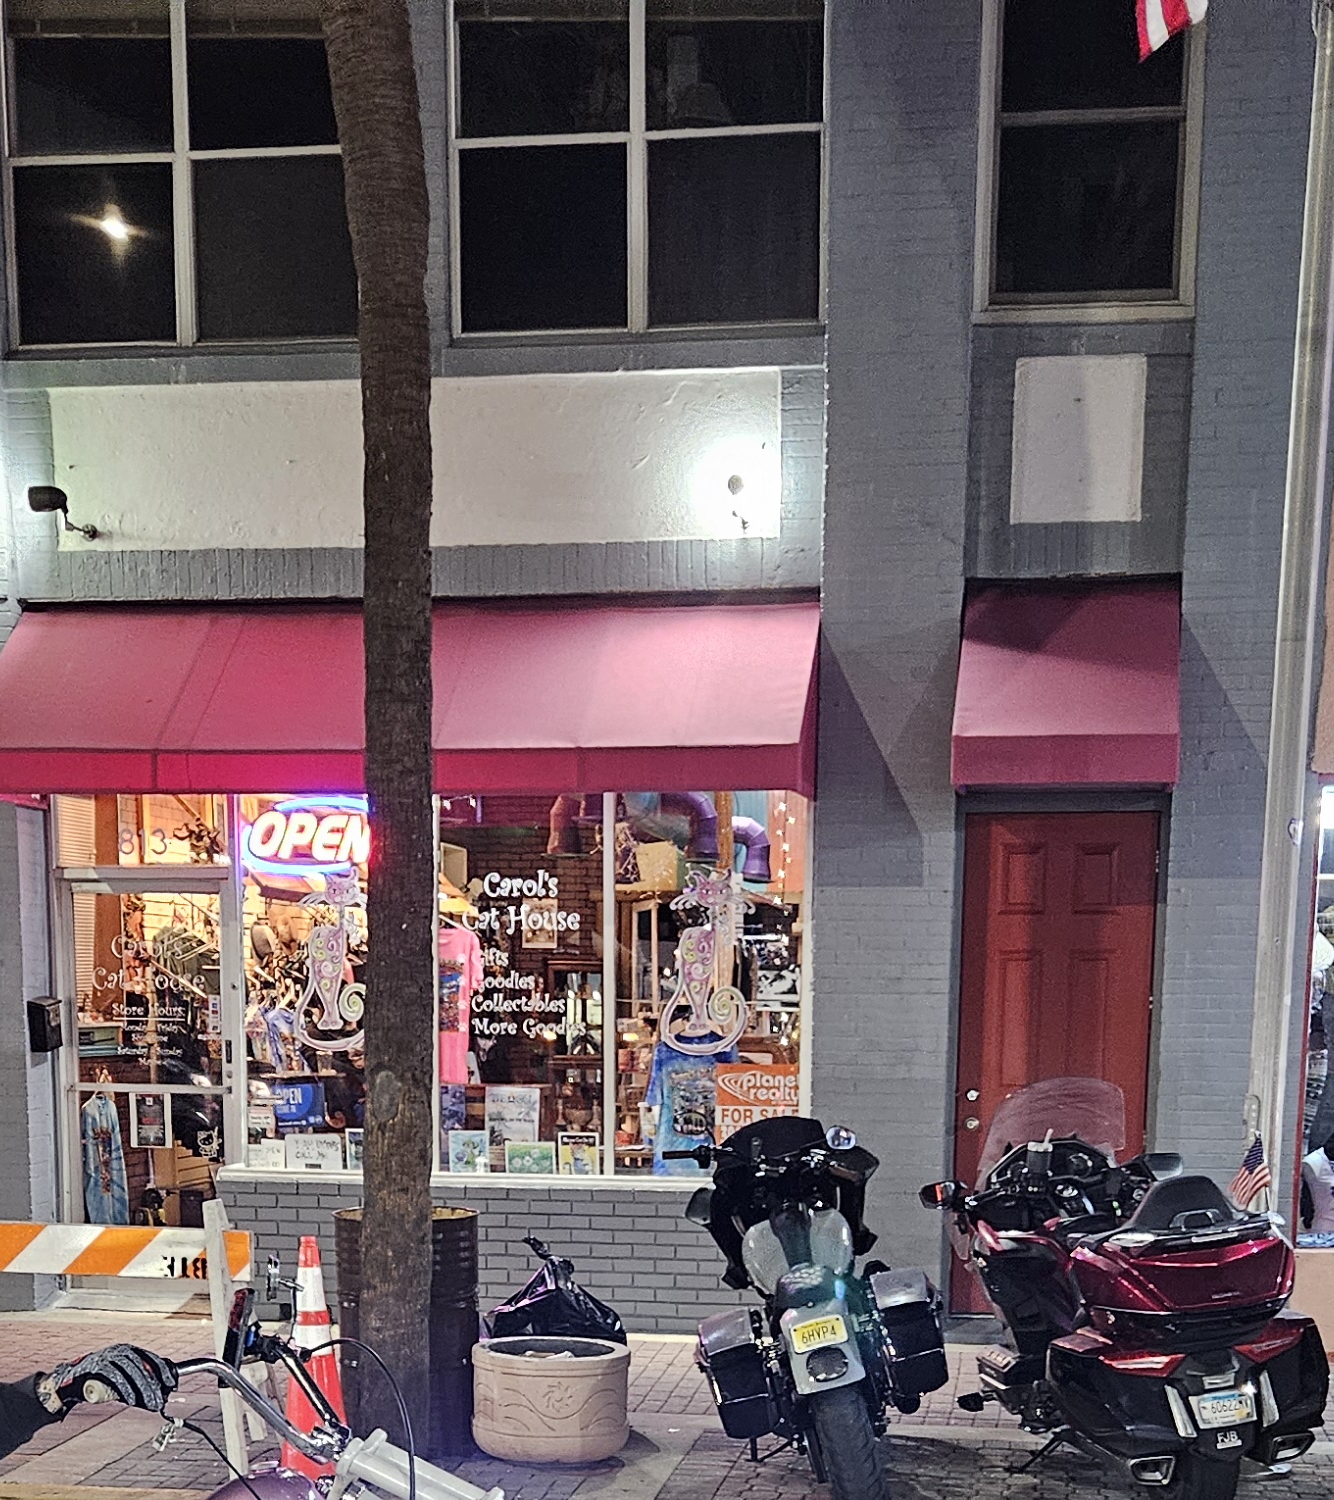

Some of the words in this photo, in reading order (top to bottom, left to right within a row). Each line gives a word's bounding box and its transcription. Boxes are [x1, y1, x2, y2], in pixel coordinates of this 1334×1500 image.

[118, 828, 168, 855] 813
[250, 811, 370, 862] OPEN
[484, 869, 559, 898] Carol's
[462, 907, 501, 931] Cat
[506, 904, 581, 935] House
[92, 966, 125, 991] Cat
[112, 1003, 145, 1016] Store
[471, 1017, 518, 1035] More
[749, 1086, 800, 1104] realty
[721, 1108, 754, 1124] FOR
